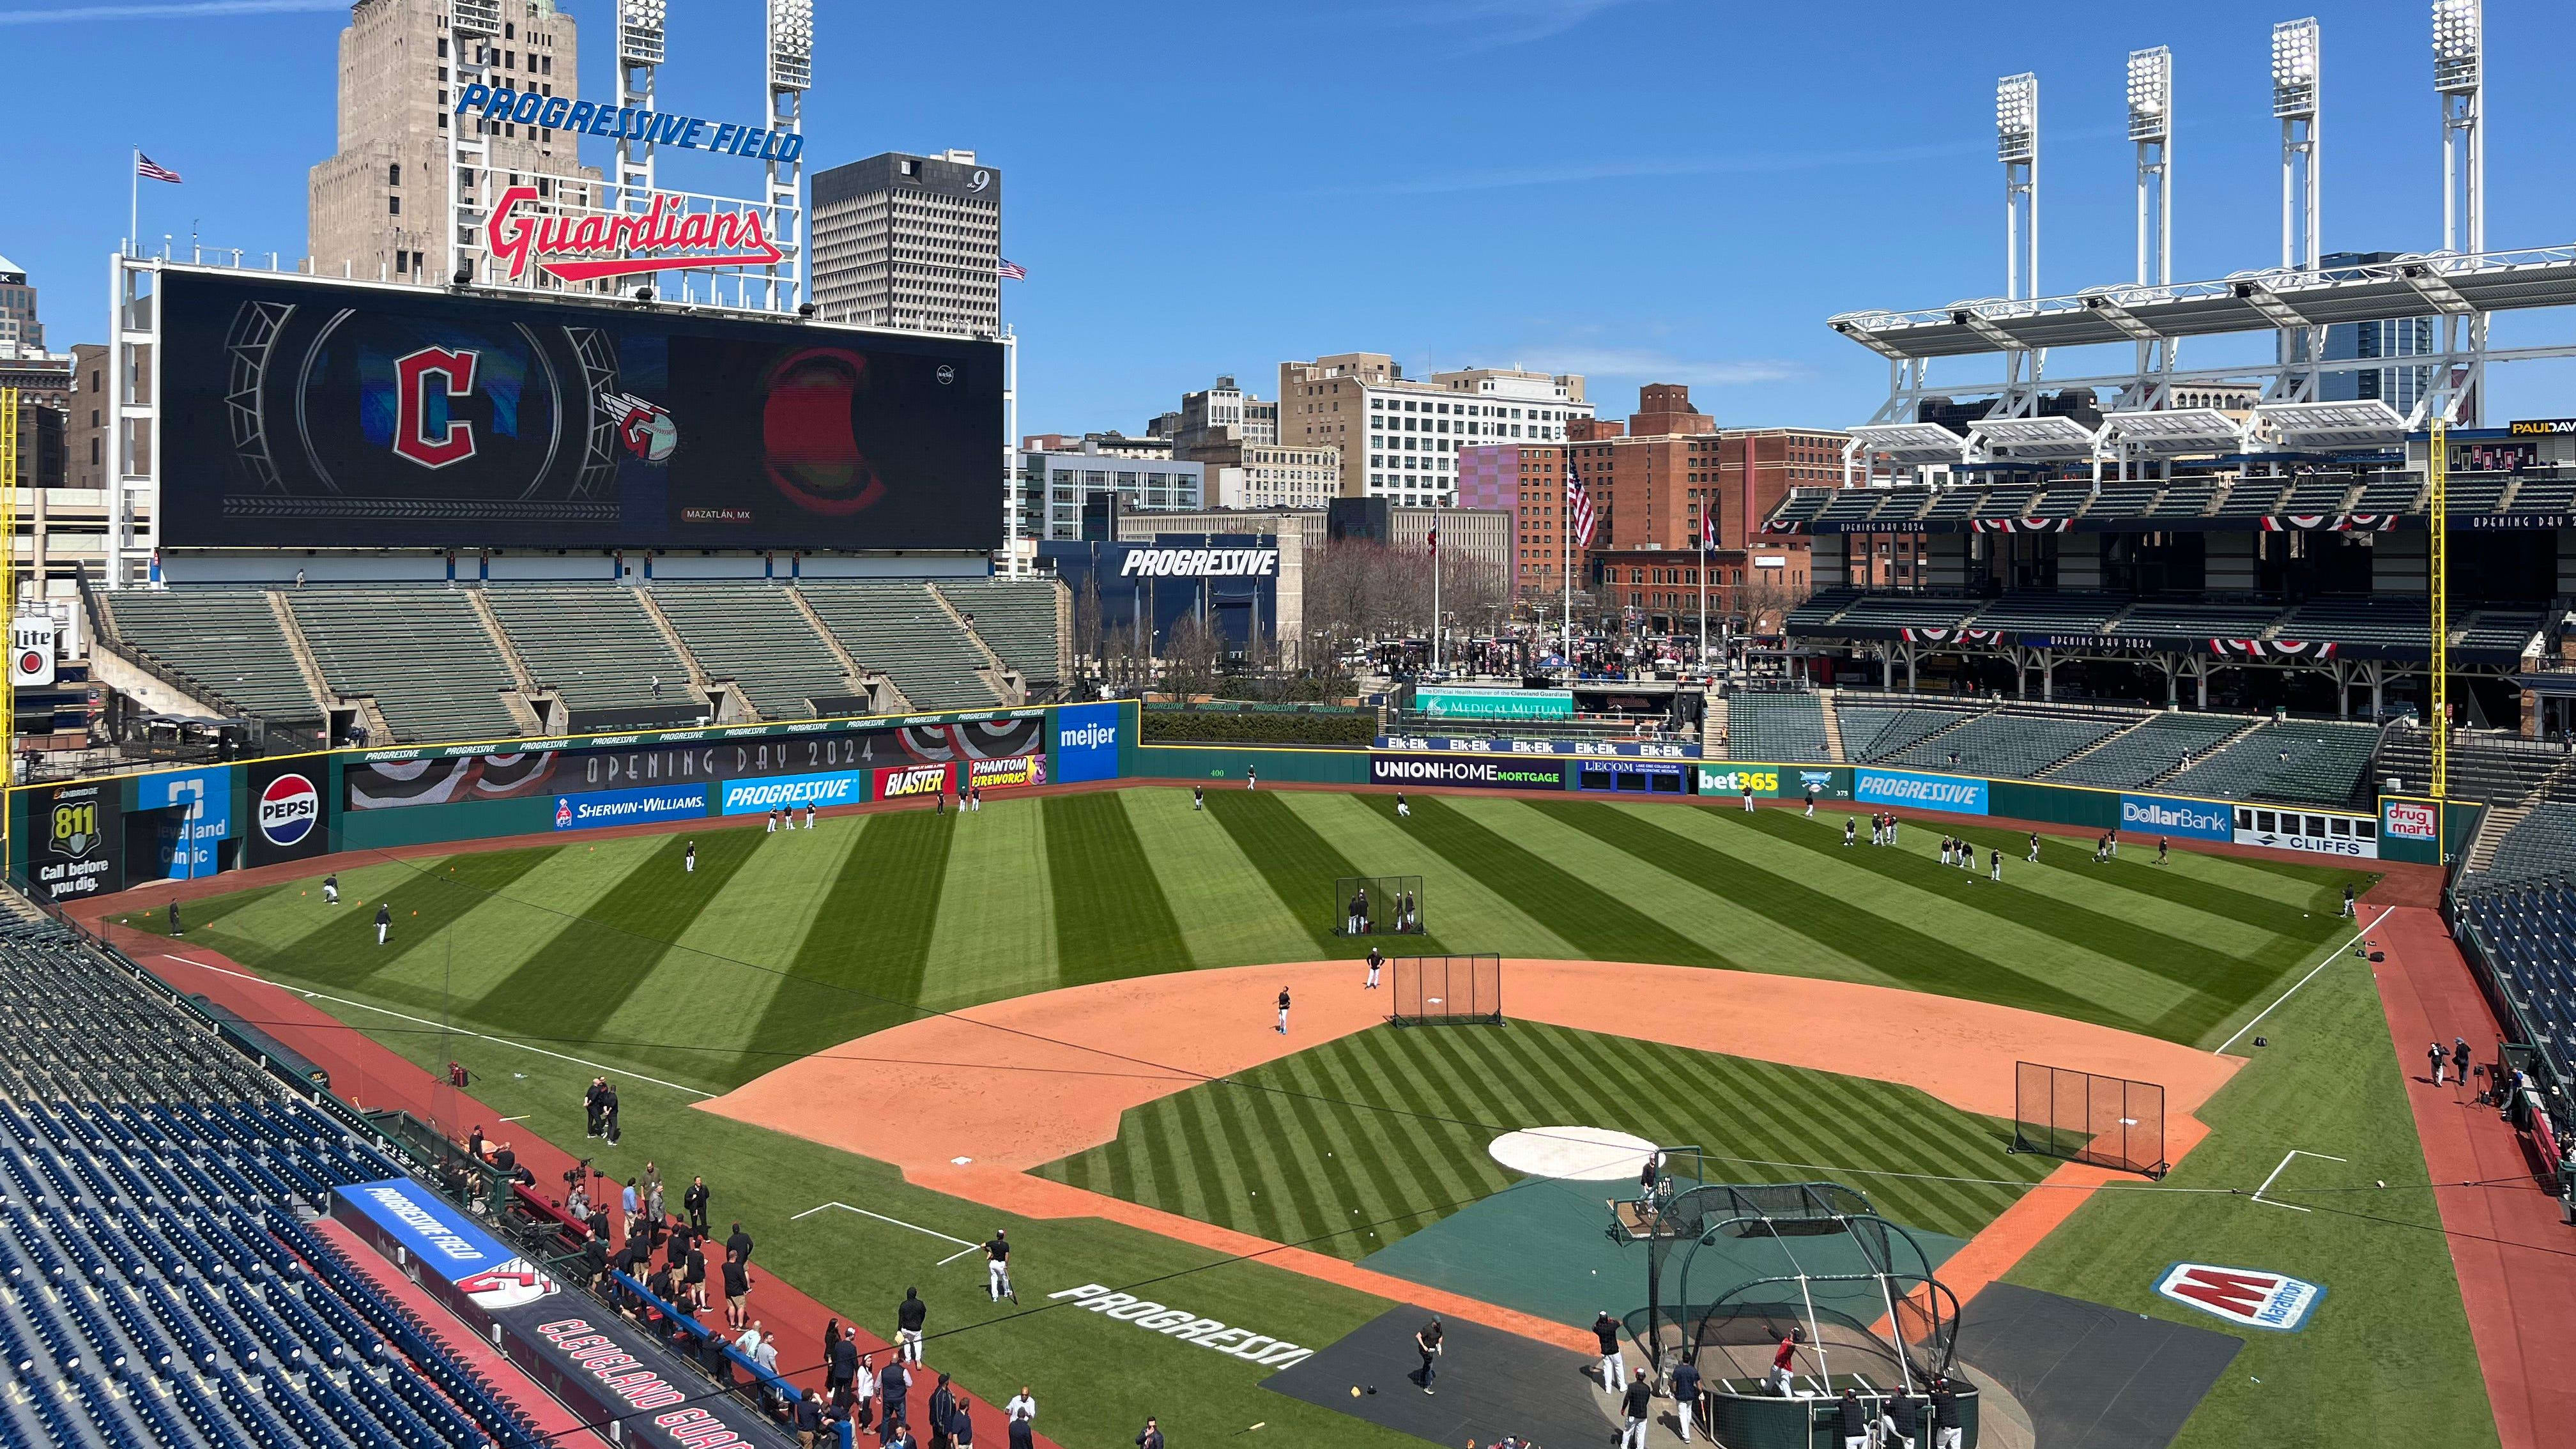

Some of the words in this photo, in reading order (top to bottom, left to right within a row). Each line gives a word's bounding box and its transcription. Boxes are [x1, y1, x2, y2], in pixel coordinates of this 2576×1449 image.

[455, 82, 706, 149] PROGRESSIVE
[709, 122, 805, 163] FIELD
[485, 185, 785, 282] Guardians
[392, 344, 479, 470] C
[1841, 523, 1876, 532] OPENING
[1882, 523, 1897, 531] DAY
[1903, 523, 1924, 531] 2024
[2474, 516, 2529, 528] OPENING
[2539, 516, 2563, 527] DAY
[1121, 549, 1278, 576] PROGRESSIVE
[14, 630, 50, 650] Lite
[2051, 636, 2092, 646] OPENING
[2100, 638, 2119, 647] DAY
[2126, 638, 2151, 648] 2024
[958, 712, 993, 720] PROGRESSIVE
[1010, 709, 1045, 717] PROGRESSIVE
[1252, 704, 1298, 712] PROGRESSIVE
[1309, 705, 1356, 714] PROGRESSIVE
[787, 723, 829, 732] PROGRESSIVE
[847, 719, 886, 728] PROGRESSIVE
[903, 715, 941, 724] PROGRESSIVE
[591, 735, 638, 745] PROGRESSIVE
[659, 731, 703, 740] PROGRESSIVE
[724, 726, 768, 736] PROGRESSIVE
[1061, 723, 1116, 750] meijer
[445, 744, 496, 755] PROGRESSIVE
[519, 740, 569, 750] PROGRESSIVE
[365, 749, 420, 760] PROGRESSIVE
[587, 749, 712, 783] OPENING
[737, 744, 787, 772] DAY
[808, 737, 874, 767] 2024
[972, 756, 1027, 774] PHANTOM
[1210, 769, 1224, 778] 400
[884, 769, 945, 797] BLASTER
[972, 771, 1026, 788] FIREWORKS
[1498, 772, 1560, 783] MORTGAGE
[1699, 770, 1778, 791] bet365
[60, 787, 99, 799] ENBRIDGE
[726, 778, 852, 808] PROGRESSIVE
[1857, 776, 1979, 806] PROGRESSIVE
[263, 799, 314, 820] PEPSI
[2389, 802, 2426, 825] drug
[56, 805, 94, 839] 811
[2393, 823, 2435, 836] mart
[2290, 837, 2360, 855] CLIFFS
[41, 864, 65, 881] Call
[68, 859, 109, 877] before
[51, 881, 74, 898] you
[75, 876, 99, 892] dig.
[364, 1187, 448, 1236] PROGRESSIVE
[429, 1229, 484, 1260] FIELD
[2258, 1281, 2306, 1324] Marathon
[1047, 1284, 1314, 1370] PROGRESSI
[537, 1319, 686, 1409] CLEVELAND
